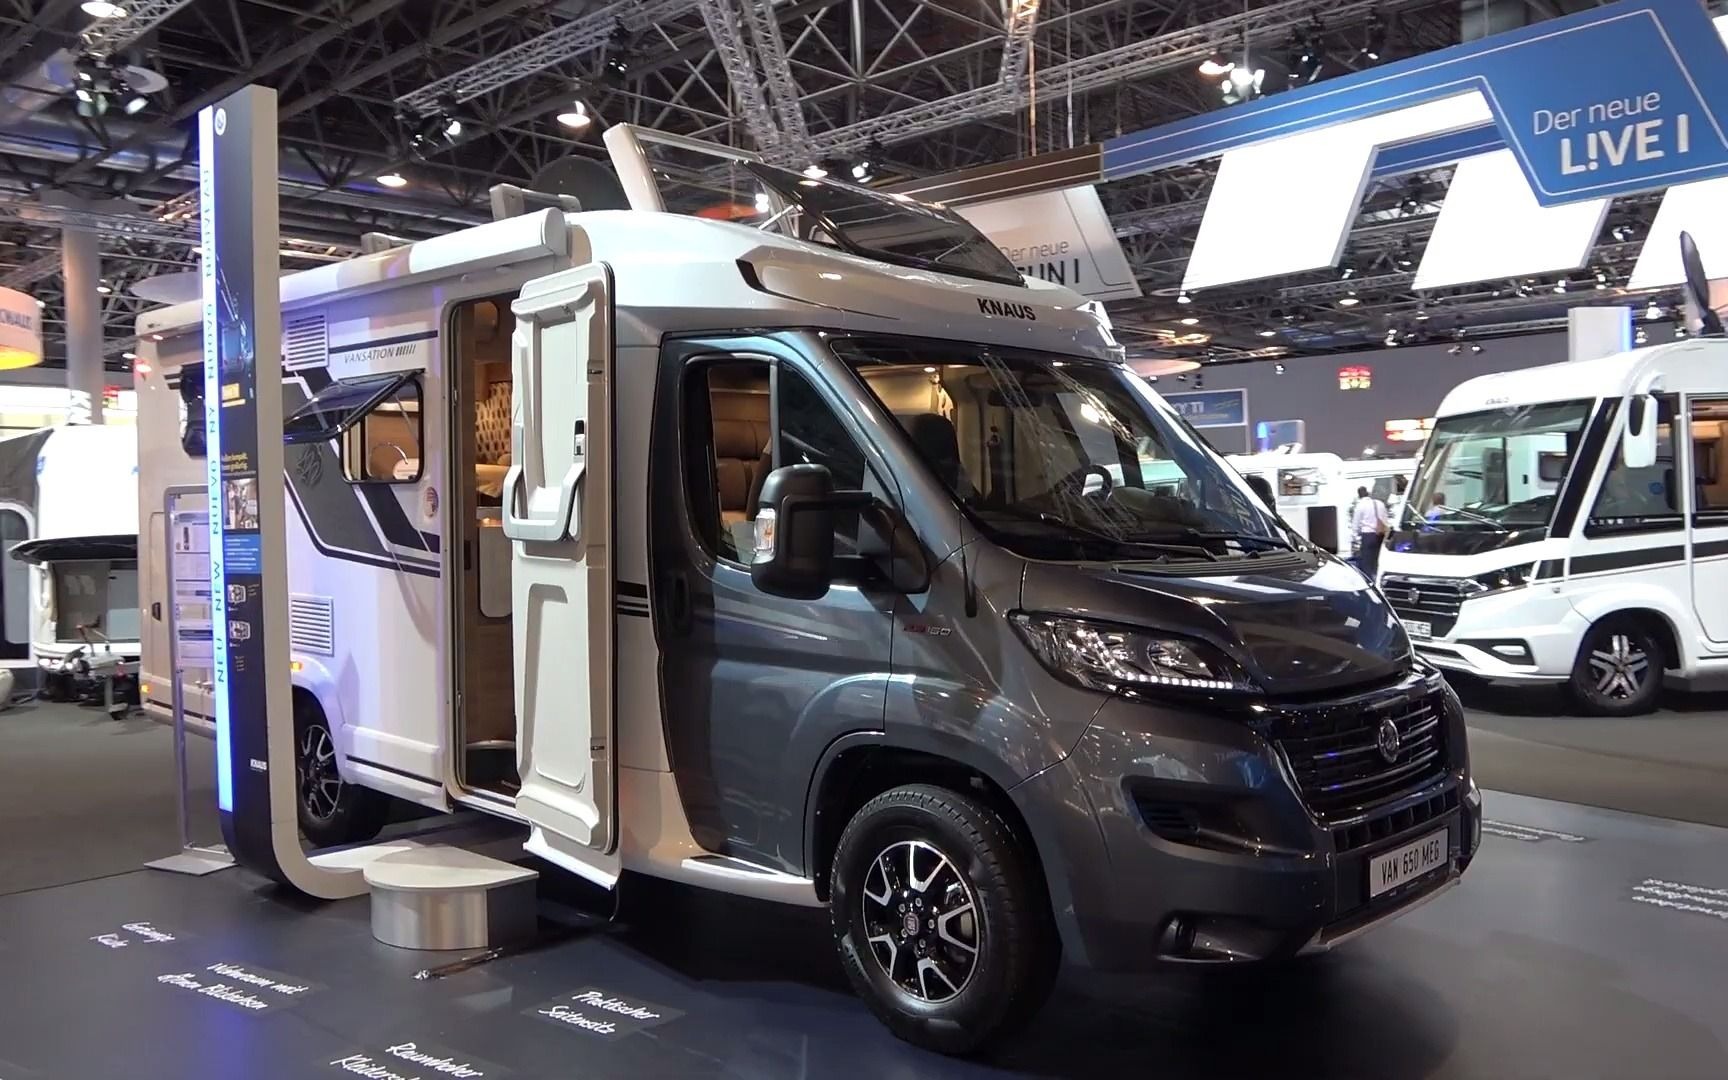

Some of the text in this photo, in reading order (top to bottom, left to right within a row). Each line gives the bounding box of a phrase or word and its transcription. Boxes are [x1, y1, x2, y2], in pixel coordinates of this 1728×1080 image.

[1533, 91, 1661, 135] Der neue
[1560, 114, 1689, 175] L!VE I
[1000, 241, 1069, 262] Der neue
[976, 297, 1037, 321] KNAUS
[344, 347, 394, 363] VANSATION
[211, 460, 219, 534] NUEVO
[213, 561, 222, 612] NEW
[216, 638, 225, 683] NEU
[1381, 840, 1440, 885] VAN 650 MEG
[538, 1005, 616, 1034] Seitensitz
[571, 991, 660, 1020] Praktischer
[385, 1042, 484, 1078] Raumhoher
